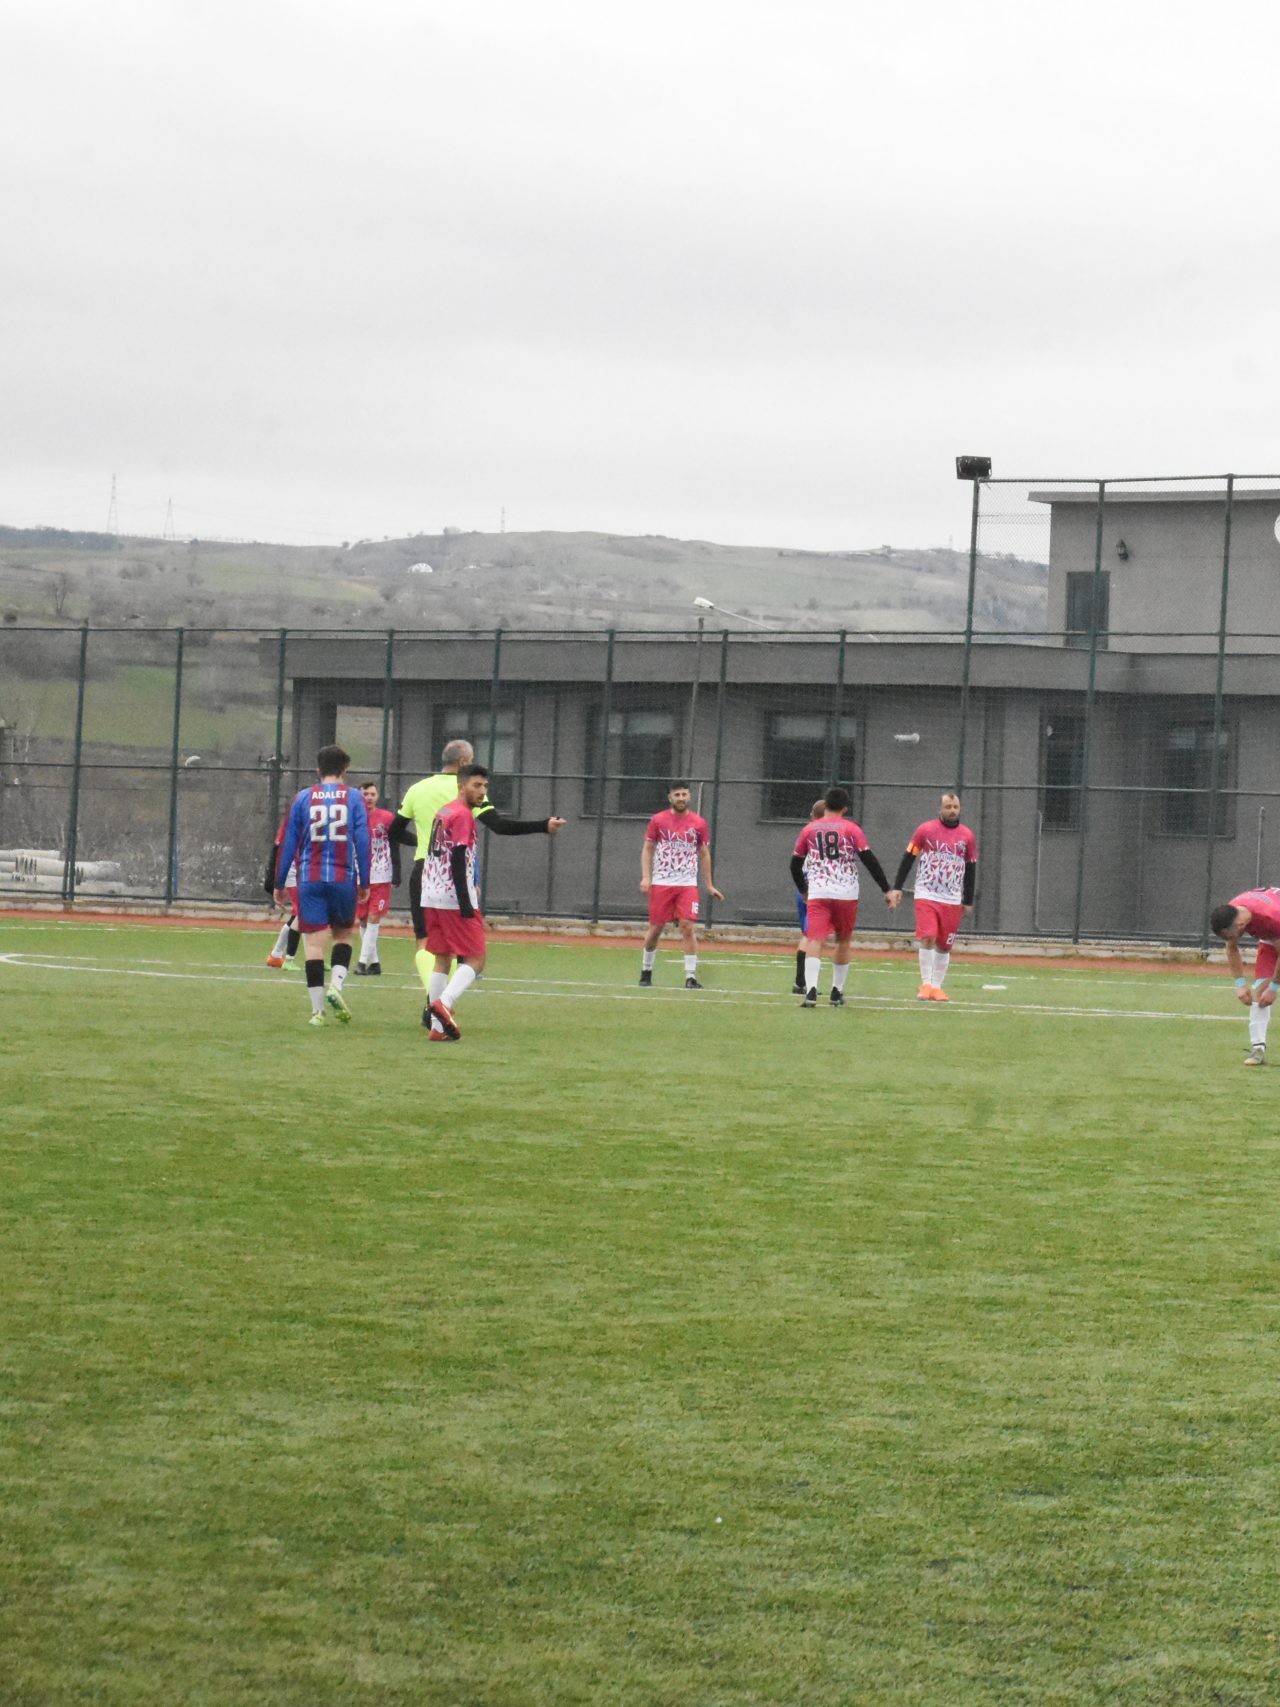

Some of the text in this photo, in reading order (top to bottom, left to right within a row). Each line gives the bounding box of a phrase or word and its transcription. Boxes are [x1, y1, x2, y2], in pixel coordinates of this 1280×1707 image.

[311, 790, 347, 800] ADALET
[309, 804, 348, 842] 22
[816, 831, 840, 860] 18
